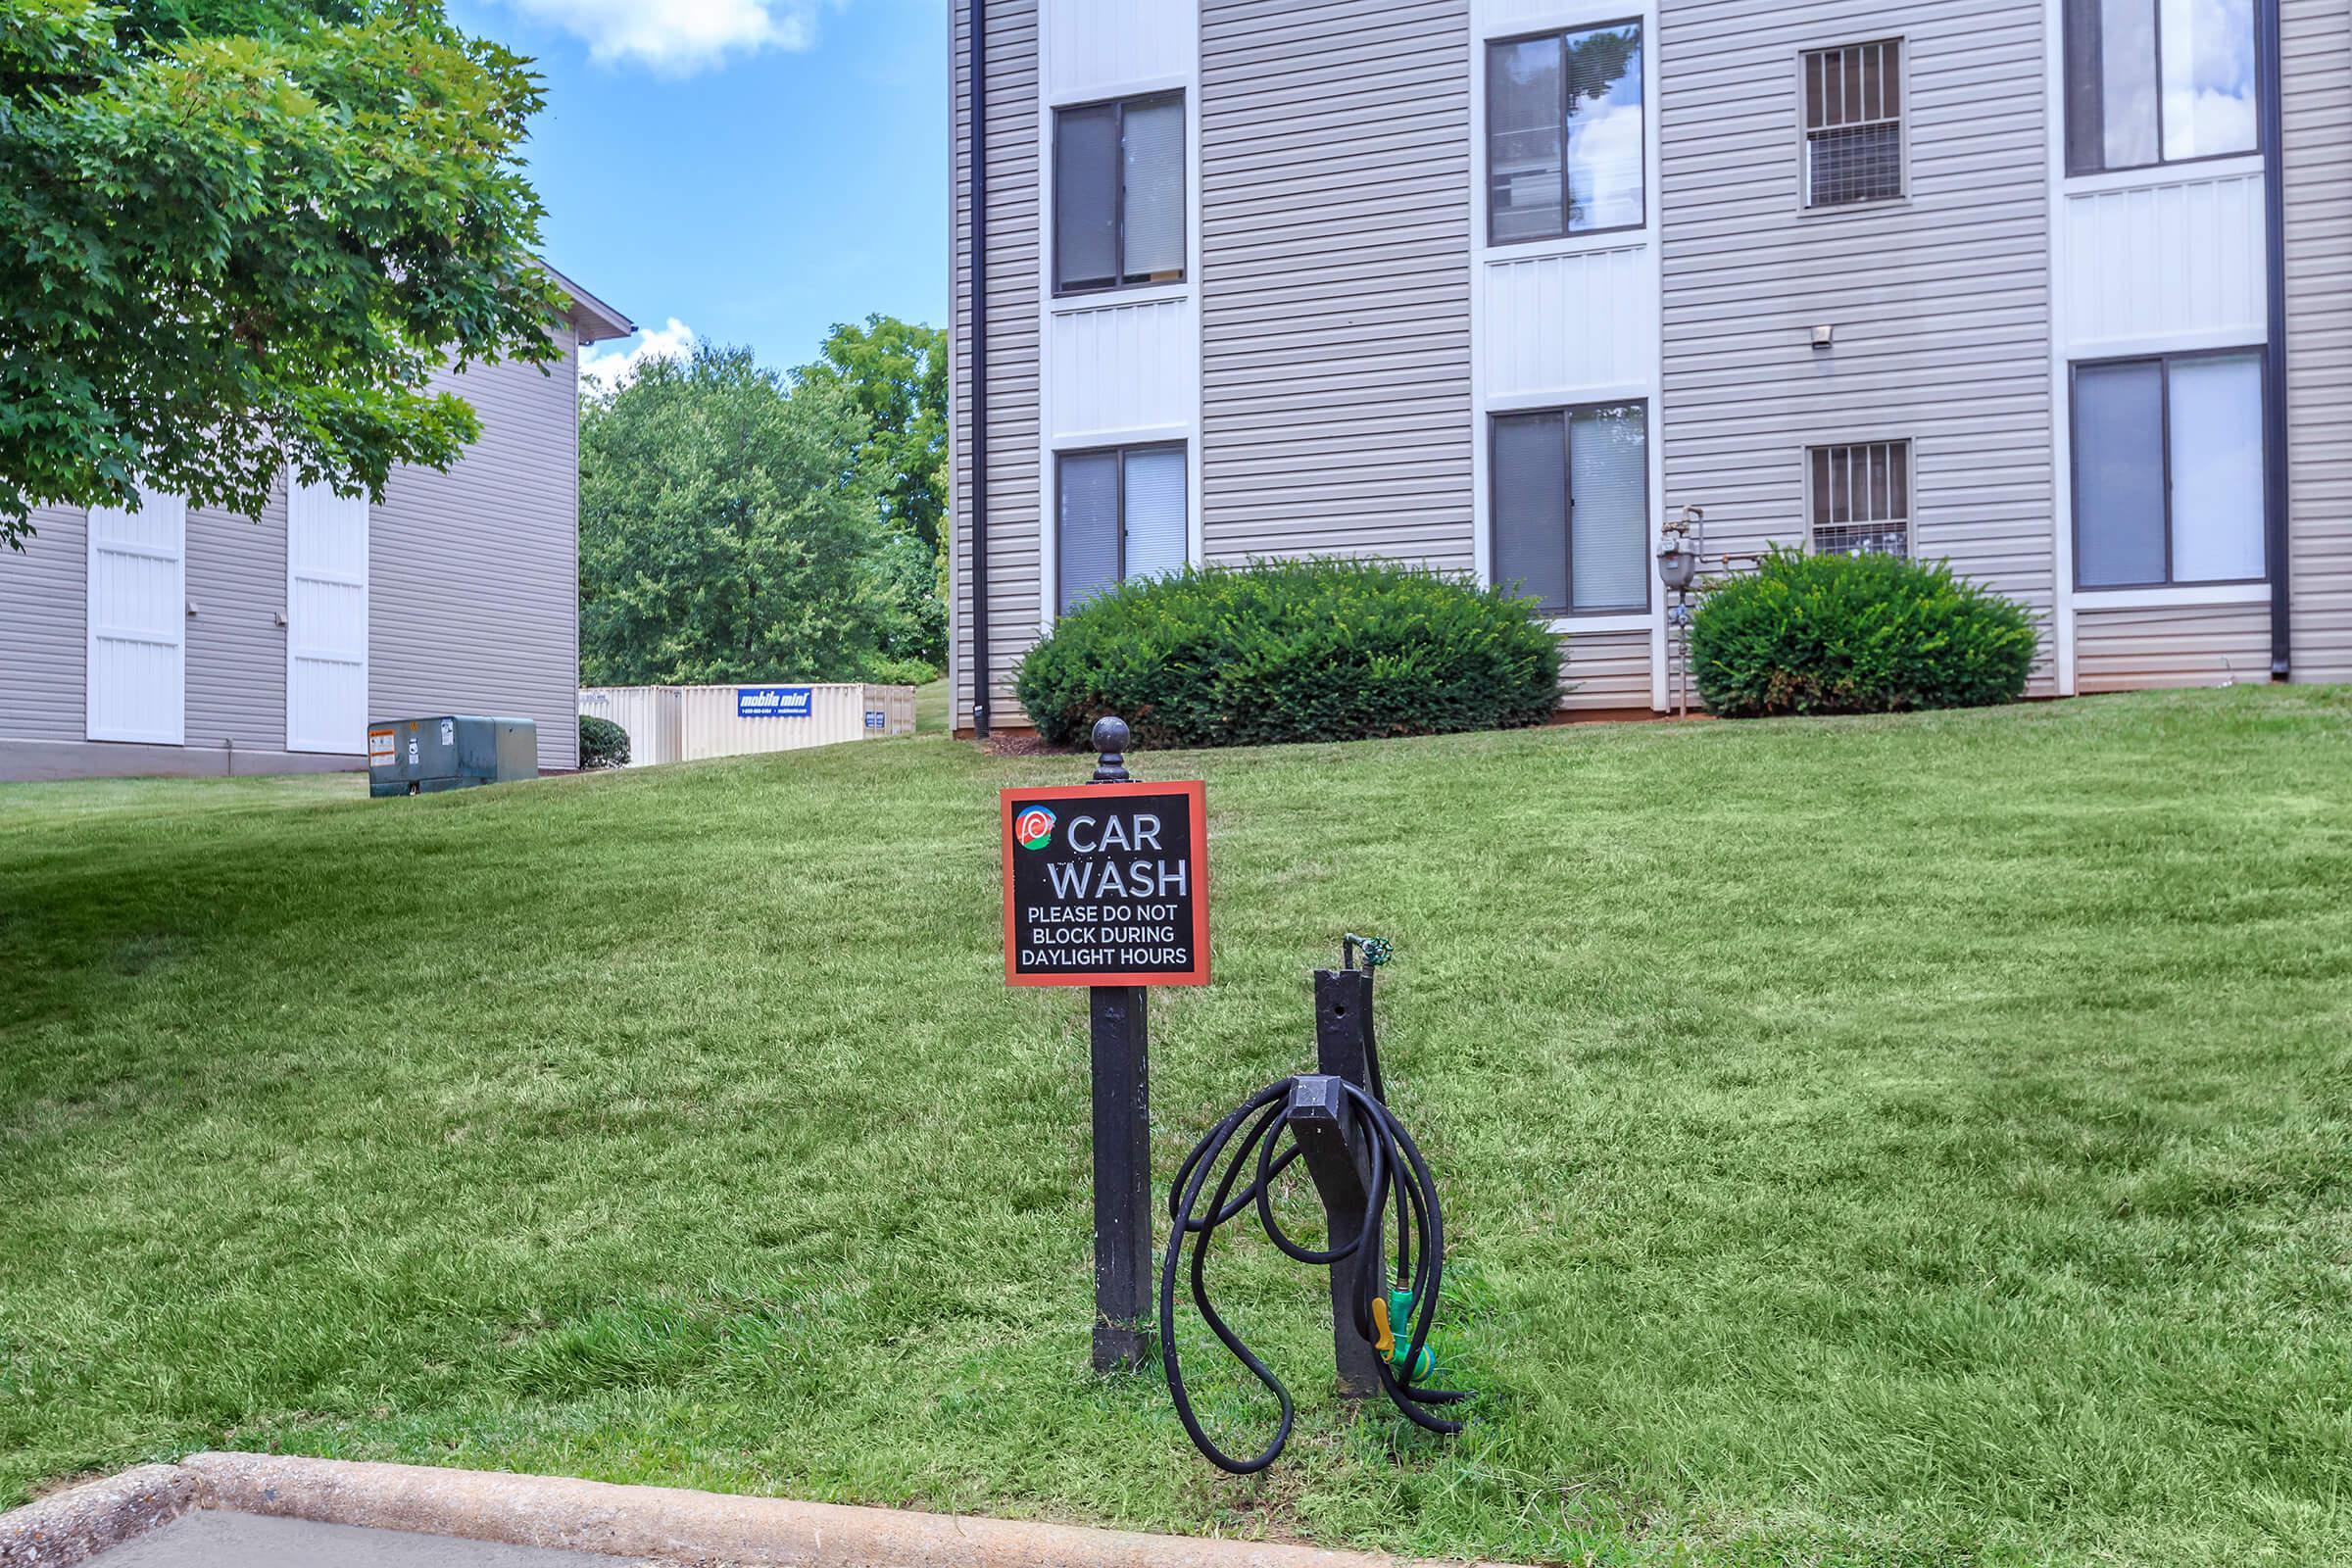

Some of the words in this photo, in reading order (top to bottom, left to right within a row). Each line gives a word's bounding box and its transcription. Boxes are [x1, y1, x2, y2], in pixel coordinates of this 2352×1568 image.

[740, 691, 780, 707] mobile
[780, 692, 809, 707] mini
[1067, 813, 1162, 853] CAR
[1047, 859, 1187, 900] WASH
[1028, 906, 1099, 923] PLEASE
[1102, 905, 1131, 922] DO
[1137, 905, 1178, 921] NOT
[1033, 927, 1097, 945] BLOCK
[1101, 926, 1174, 944] DURING
[1022, 949, 1115, 965] DAYLIGHT
[1120, 948, 1187, 964] HOURS
